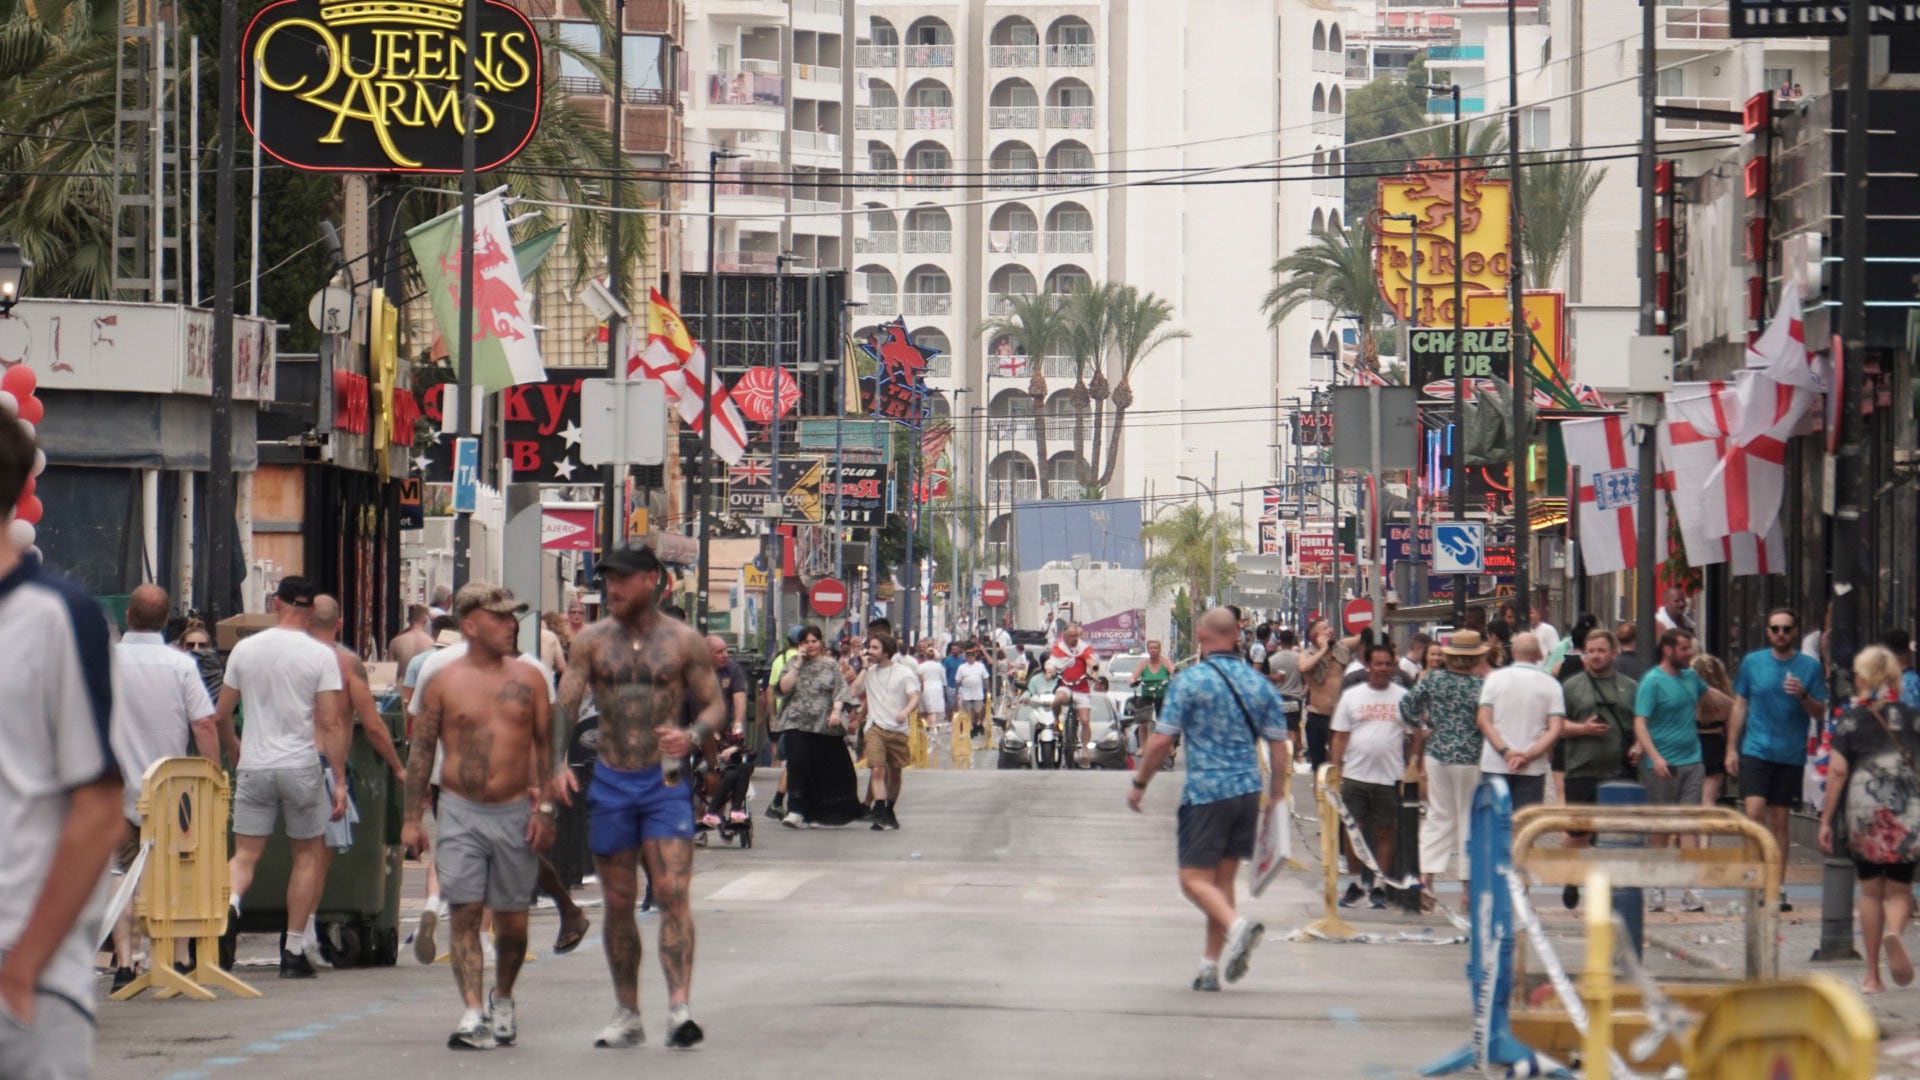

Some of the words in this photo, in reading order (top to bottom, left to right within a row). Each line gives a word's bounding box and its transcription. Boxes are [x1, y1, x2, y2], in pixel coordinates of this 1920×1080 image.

[1799, 6, 1848, 24] BES
[1868, 5, 1896, 22] IN
[254, 18, 531, 98] QUEENS
[315, 78, 496, 168] ARMS
[1394, 287, 1465, 322] Lio
[840, 467, 878, 477] CLUB
